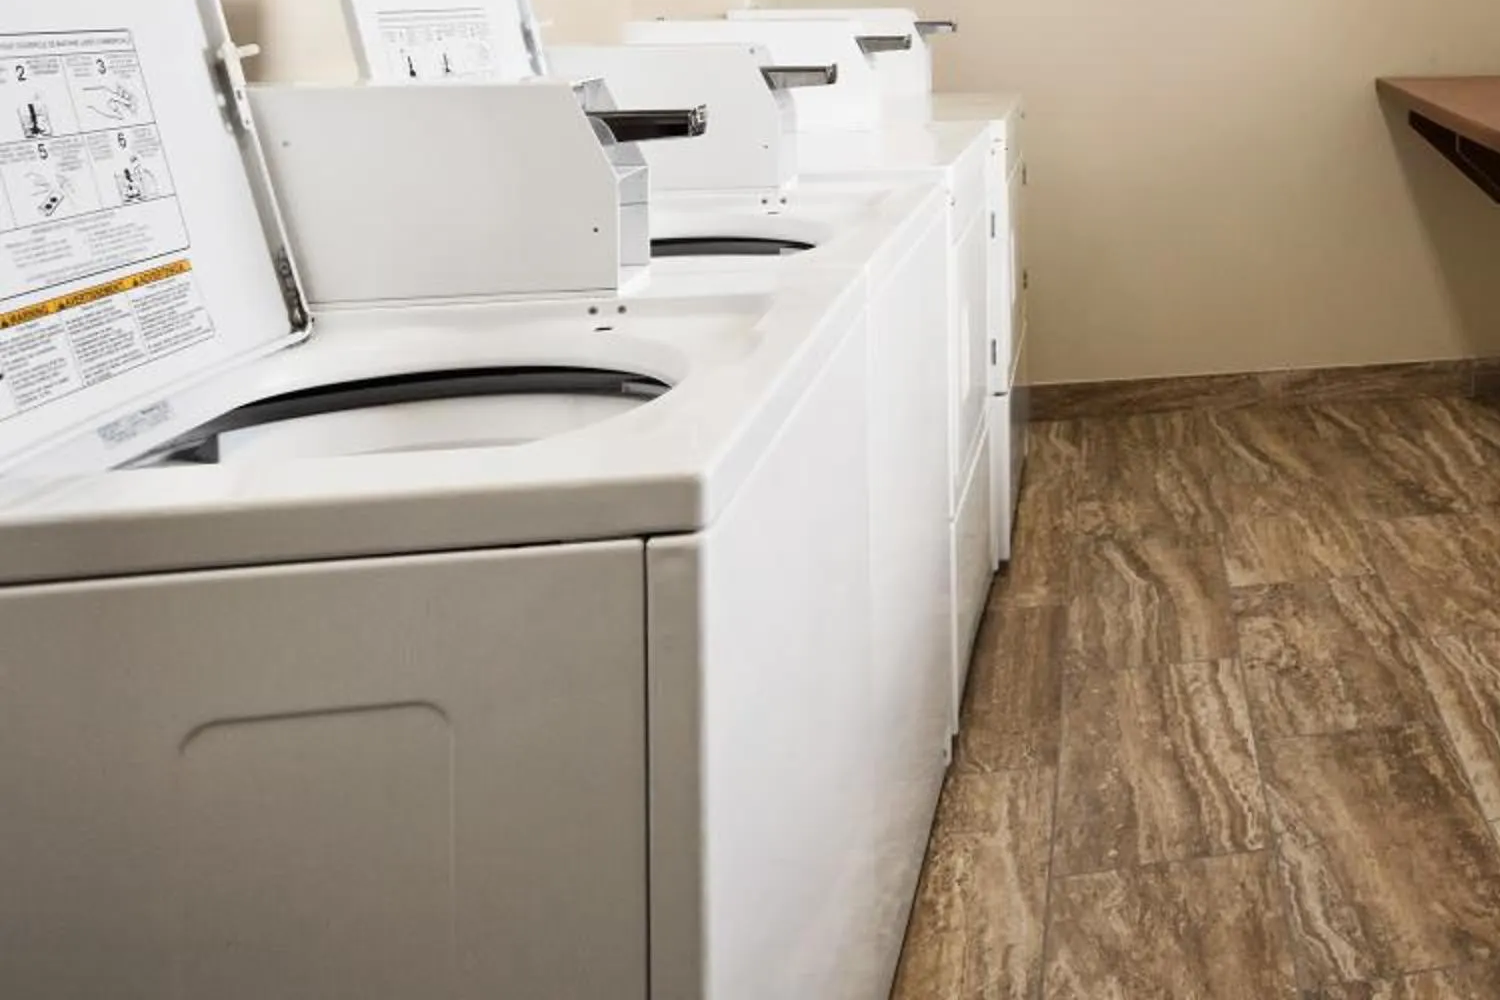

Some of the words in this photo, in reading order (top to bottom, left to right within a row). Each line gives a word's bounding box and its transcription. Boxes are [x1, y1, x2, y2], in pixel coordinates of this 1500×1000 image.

[16, 65, 27, 81] 2
[96, 58, 107, 74] 3
[37, 143, 49, 160] 5
